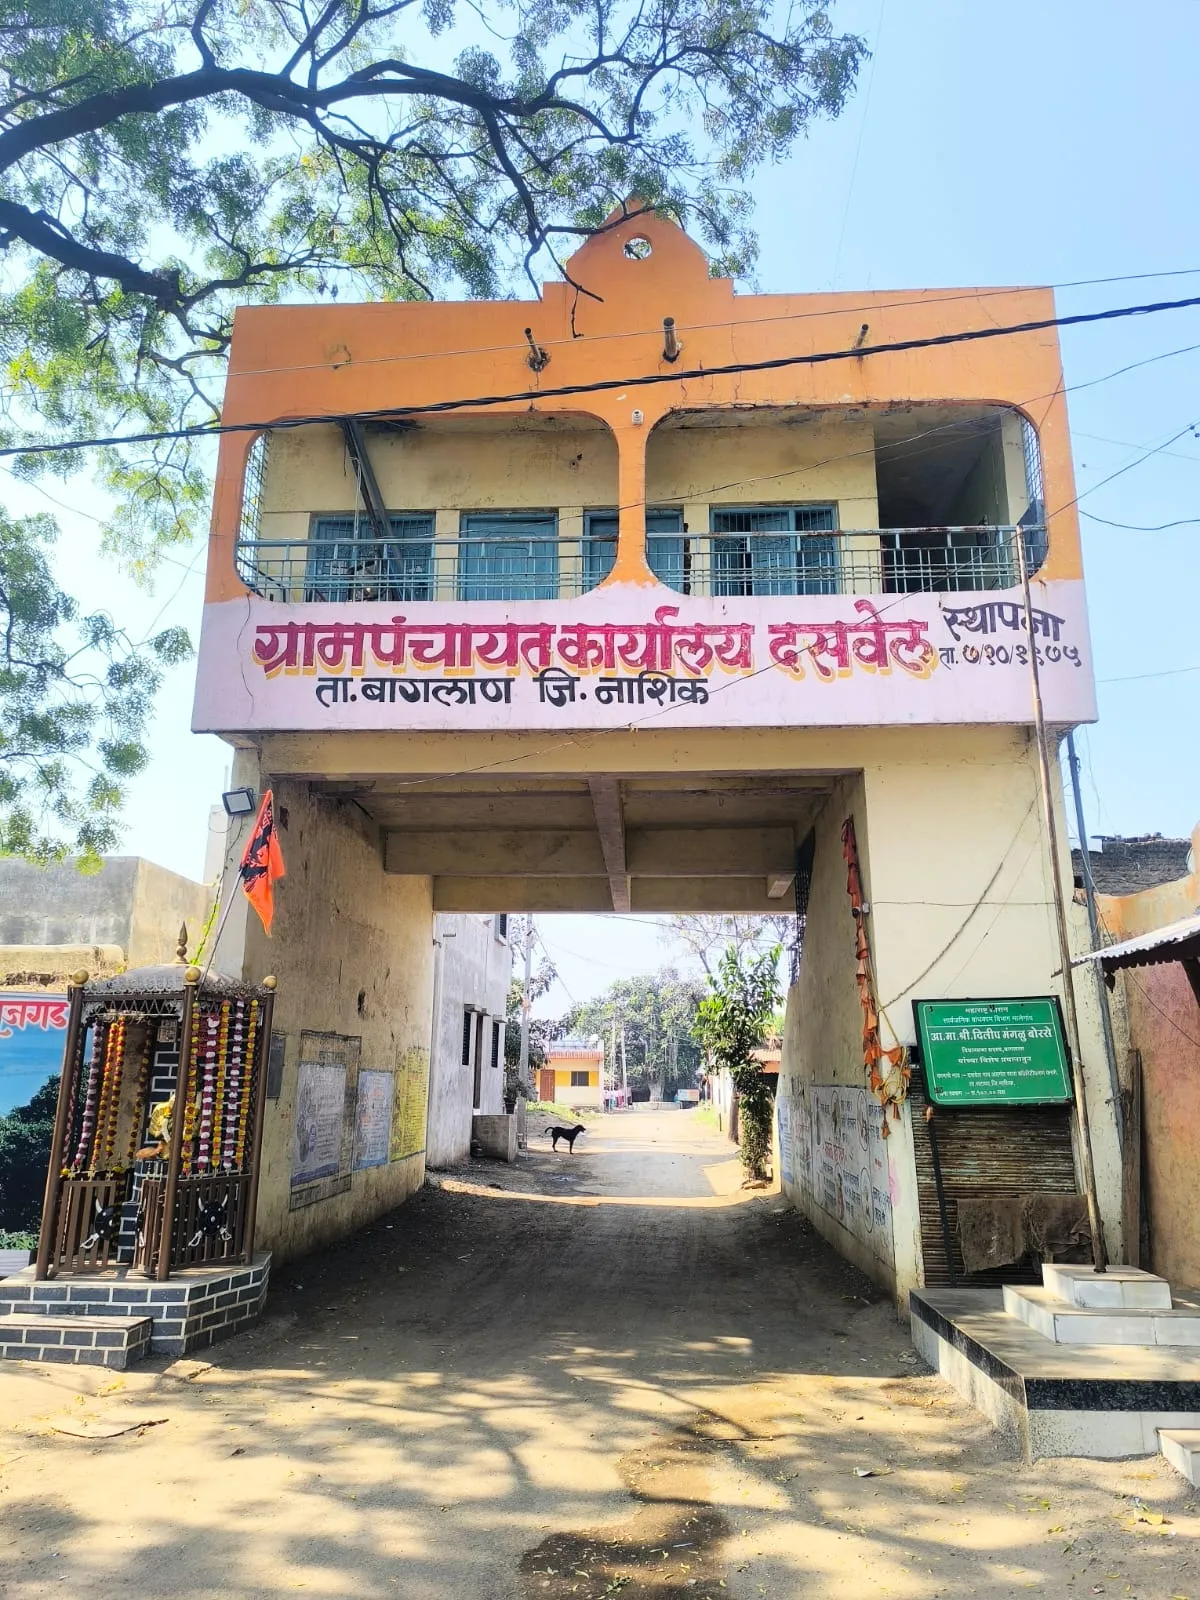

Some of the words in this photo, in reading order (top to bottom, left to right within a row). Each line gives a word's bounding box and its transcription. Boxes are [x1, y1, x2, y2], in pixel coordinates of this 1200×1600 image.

[254, 615, 556, 677] ग्रामपंचायत
[561, 605, 756, 677] कार्यालय
[768, 599, 937, 681] दसवेल
[939, 647, 959, 671] ता.
[594, 670, 710, 708] नाशिक
